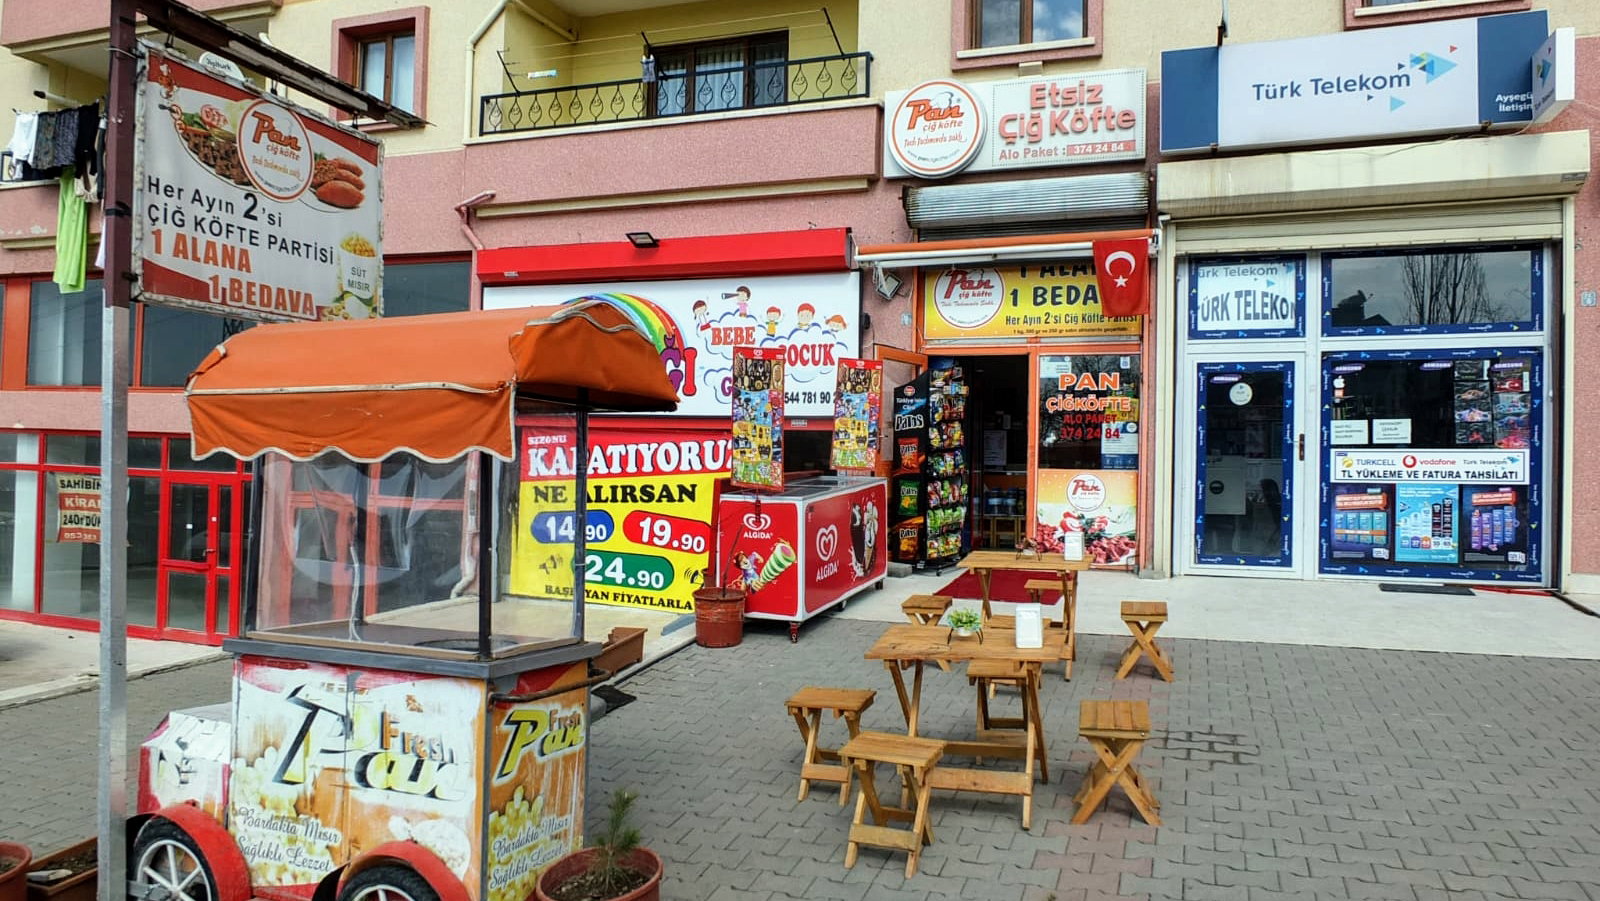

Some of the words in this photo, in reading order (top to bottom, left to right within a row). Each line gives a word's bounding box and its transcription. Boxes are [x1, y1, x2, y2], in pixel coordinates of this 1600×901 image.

[1030, 81, 1103, 109] Etsiz
[1252, 82, 1301, 101] Türk
[1310, 71, 1411, 97] Telekom
[906, 99, 964, 130] Pan
[999, 113, 1043, 144] Çiğ
[1050, 106, 1136, 136] Köfte
[251, 110, 302, 152] Pan
[1000, 149, 1020, 160] Alo
[1024, 146, 1058, 160] Paket
[1074, 144, 1092, 154] 374
[1095, 144, 1108, 153] 24
[1111, 142, 1124, 152] 84
[147, 174, 185, 202] Her
[190, 187, 236, 216] Ayın
[147, 203, 186, 228] ÇİĞ
[194, 214, 261, 247] KÖFTE
[267, 233, 334, 265] PARTİSİ
[151, 228, 163, 256] 1
[172, 232, 252, 274] ALANA
[348, 278, 371, 293] MISIR
[350, 264, 367, 279] SÜT
[944, 270, 994, 300] Pan
[1224, 266, 1278, 277] Telekom
[208, 274, 220, 300] 1
[228, 278, 318, 320] BEDAVA
[1010, 288, 1018, 308] 1
[1198, 292, 1230, 322] ÜRK
[1006, 315, 1020, 326] Her
[1023, 314, 1042, 326] Ayın
[1082, 313, 1104, 324] Köfte
[711, 326, 756, 346] BEBE
[1058, 372, 1120, 390] PAN
[802, 391, 816, 404] 781
[820, 391, 831, 402] 90
[1046, 394, 1130, 414] ÇİĞKÖFTE
[1060, 428, 1082, 439] 374
[1086, 428, 1101, 438] 24
[1105, 428, 1120, 438] 84
[1064, 414, 1082, 424] ALO
[1086, 414, 1118, 424] PAKET
[527, 439, 732, 476] KAATIYORU
[1342, 470, 1353, 478] TL
[1356, 468, 1404, 478] YÜKLEME
[1406, 470, 1419, 478] VE
[1422, 470, 1462, 479] FATURA
[1465, 469, 1518, 480] TAHSİLATI
[64, 496, 101, 508] KİRA
[532, 485, 568, 504] NE
[546, 516, 607, 542] 1490
[640, 516, 706, 552] 19.90
[586, 554, 664, 589] 24.90
[612, 590, 692, 610] FİYATLARLA
[380, 709, 455, 764] Fresh
[238, 806, 298, 836] Bardakta
[303, 816, 340, 846] Mısır
[493, 830, 539, 859] Bardakta
[540, 816, 571, 841] Mısır
[238, 834, 284, 864] Sağlıklı
[286, 846, 332, 873] Lezzet
[490, 858, 530, 890] Sağlıklı
